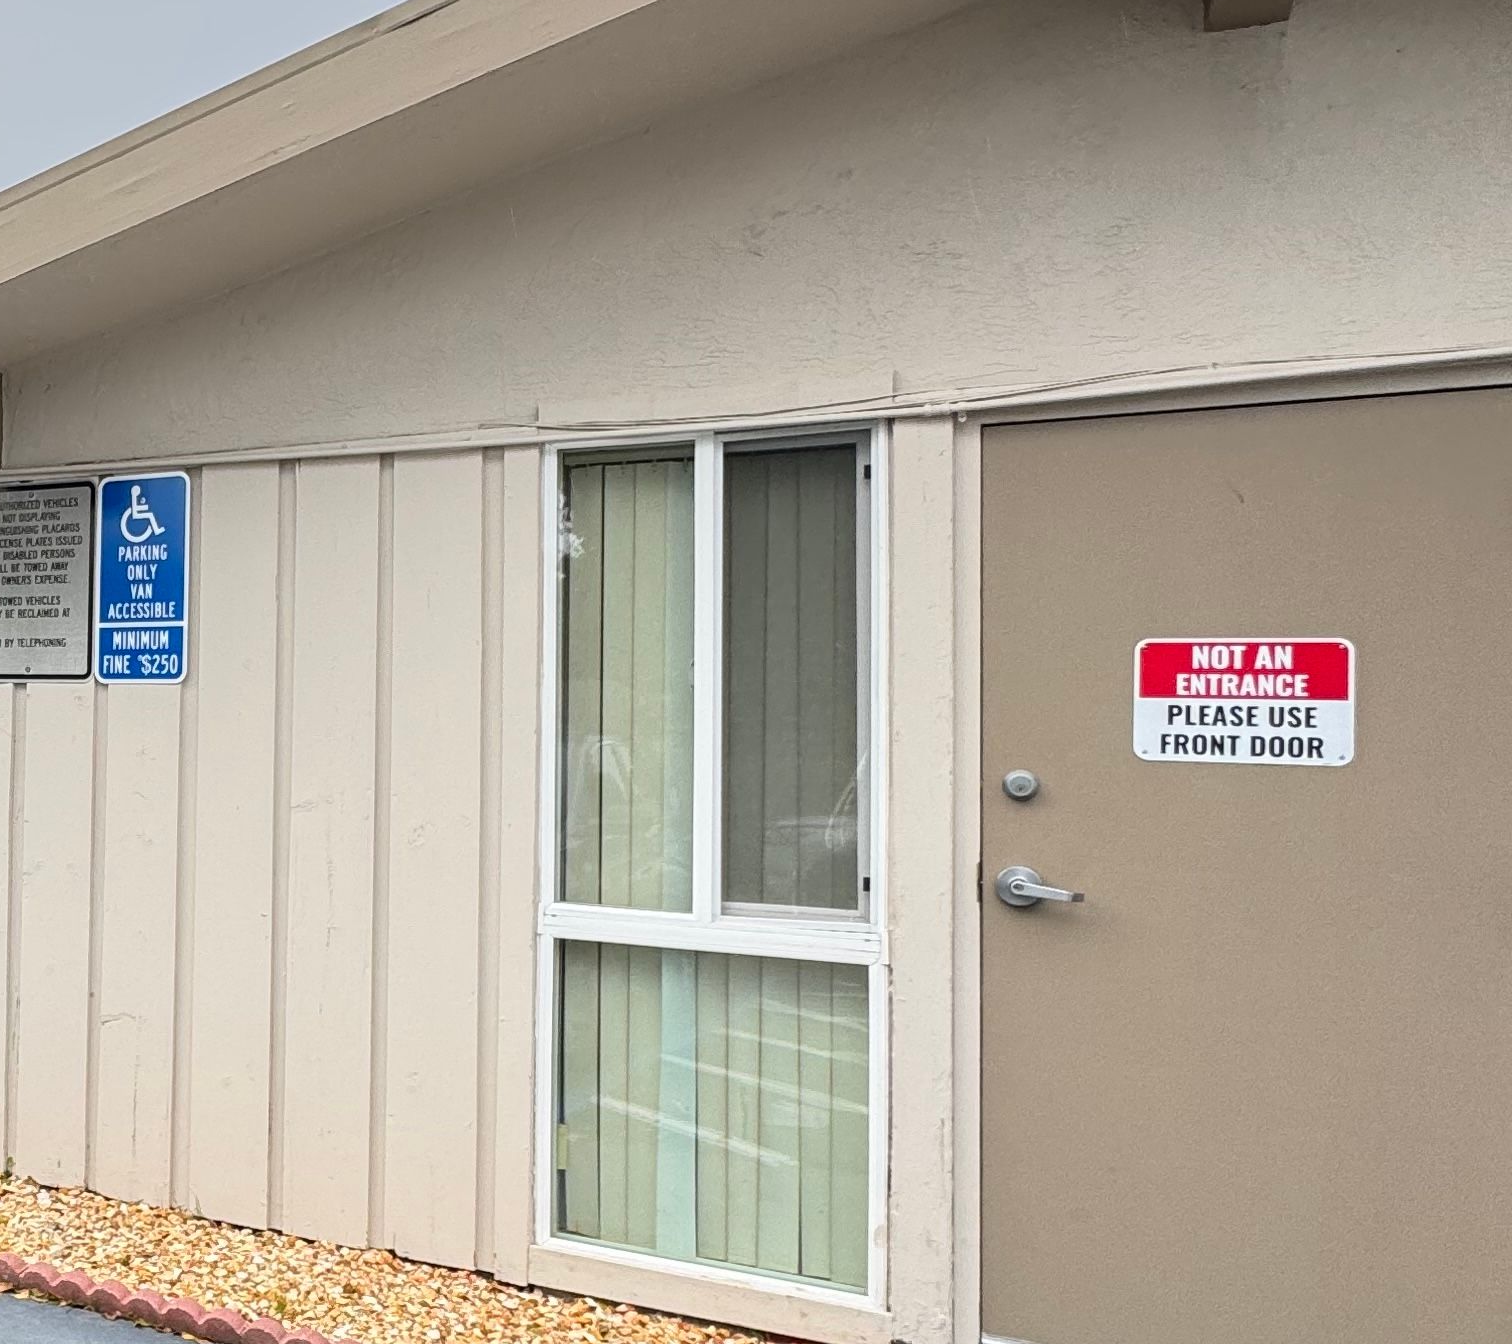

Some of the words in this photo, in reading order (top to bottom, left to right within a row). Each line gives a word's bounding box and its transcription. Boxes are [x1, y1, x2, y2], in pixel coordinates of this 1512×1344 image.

[43, 497, 79, 508] VEHICLES
[2, 514, 16, 523] NOT
[18, 511, 61, 522] DISPLAYING
[41, 523, 80, 534] PLACARDS
[26, 537, 52, 547] PLATES
[55, 536, 83, 546] ISSUED
[3, 550, 37, 560] DISABLED
[41, 549, 75, 559] PERSONS
[118, 544, 168, 562] PARKING
[11, 563, 20, 572] BE
[24, 562, 47, 572] TOWED
[50, 561, 68, 571] AWAY
[127, 564, 158, 581] ONLY
[130, 583, 153, 600] VAN
[0, 596, 22, 606] TOWED
[26, 596, 60, 605] VEHICLES
[5, 609, 15, 618] BE
[18, 608, 59, 618] RECLAIMED
[62, 607, 70, 617] AT
[108, 601, 176, 619] ACCESSIBLE
[5, 638, 14, 648] BY
[17, 638, 66, 648] TELEPHONING
[112, 630, 169, 650] MINIMUM
[102, 654, 131, 674] FINE
[140, 653, 178, 676] $250
[1191, 645, 1248, 669] NOT
[1254, 645, 1294, 670] AN
[1175, 673, 1309, 697] ENTRANCE
[1167, 704, 1260, 727] PLEASE
[1269, 706, 1318, 728] USE
[1160, 733, 1241, 756] FRONT
[1250, 735, 1324, 759] DOOR
